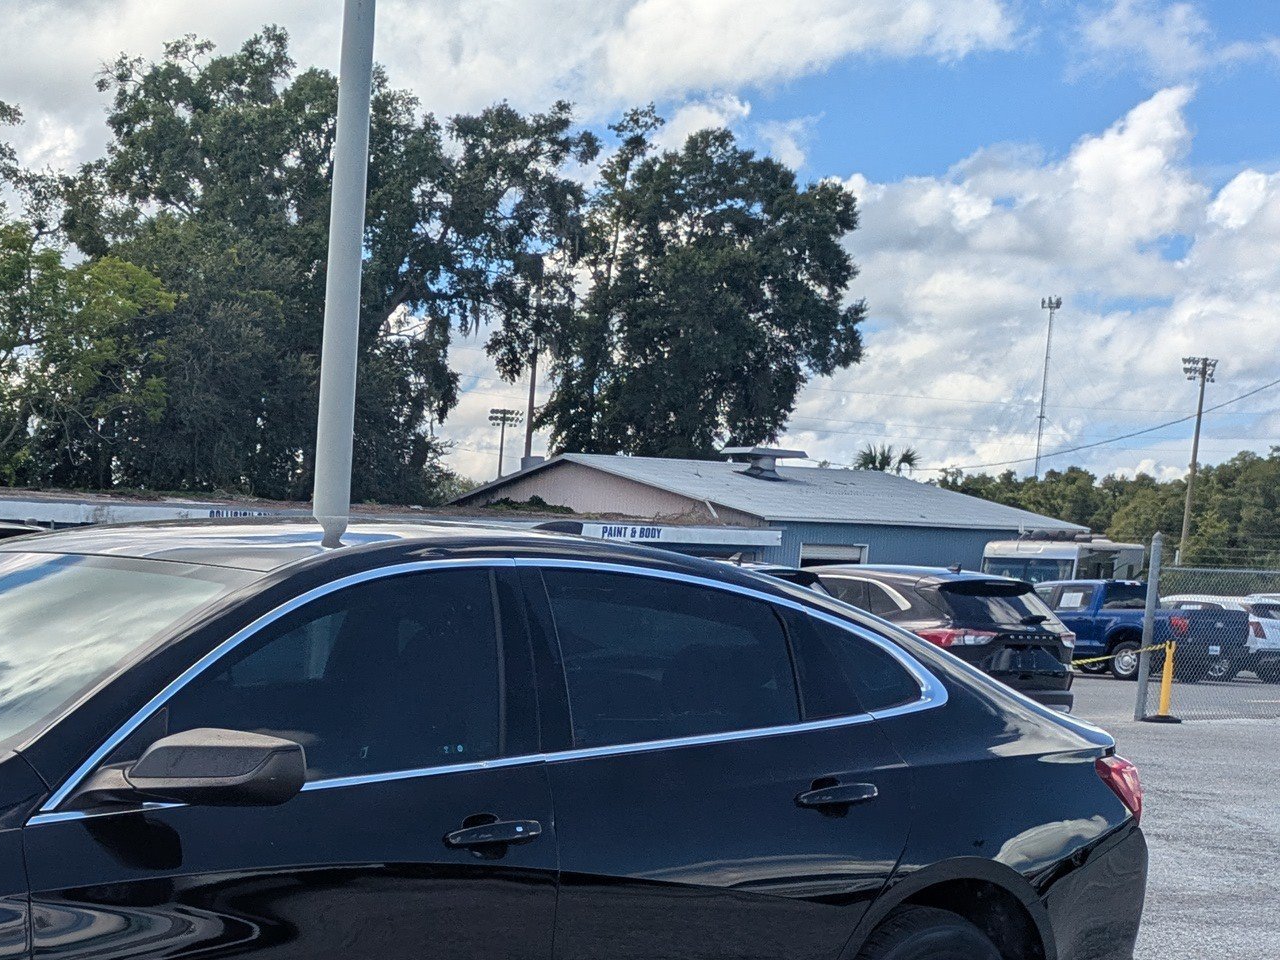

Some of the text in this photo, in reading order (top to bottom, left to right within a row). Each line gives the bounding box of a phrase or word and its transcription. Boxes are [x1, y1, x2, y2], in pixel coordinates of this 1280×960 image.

[602, 526, 662, 538] PAINT & BODY
